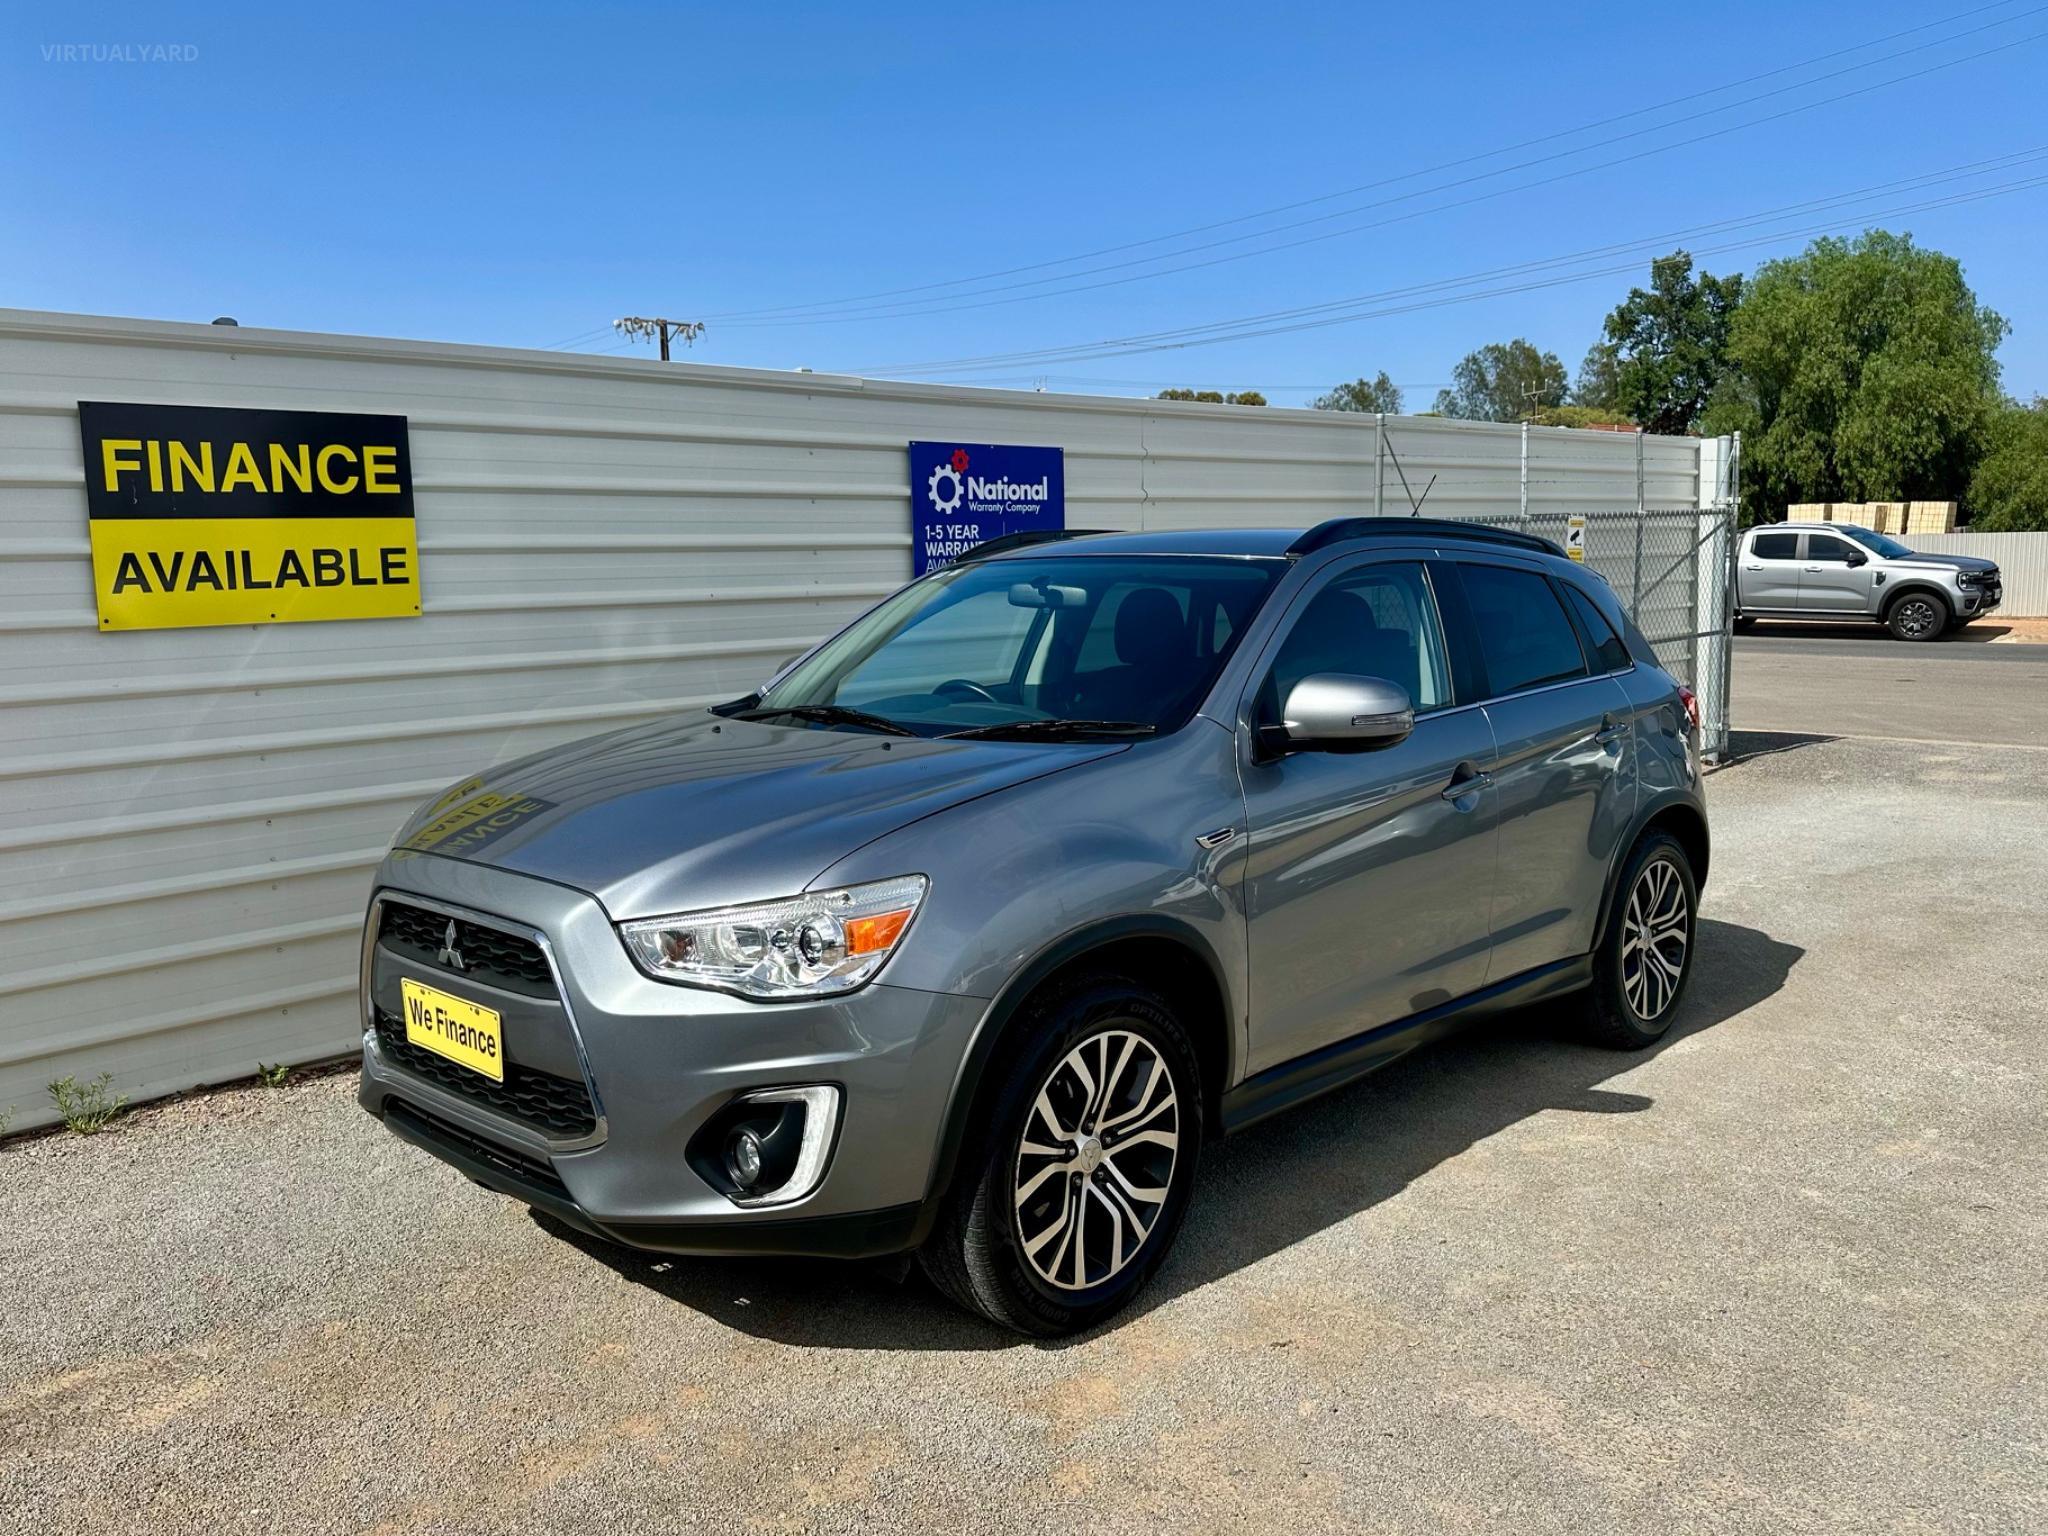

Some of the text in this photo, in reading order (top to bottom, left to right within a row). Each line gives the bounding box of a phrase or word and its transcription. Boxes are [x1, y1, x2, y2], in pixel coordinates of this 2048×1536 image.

[101, 438, 401, 495] FINANCE
[967, 475, 1047, 501] National
[968, 501, 1040, 515] Warranty Company
[925, 524, 979, 539] 1-5 YEAR
[925, 541, 986, 557] WARRAN
[112, 547, 410, 595] AVAILABLE
[408, 996, 496, 1058] We Finance
